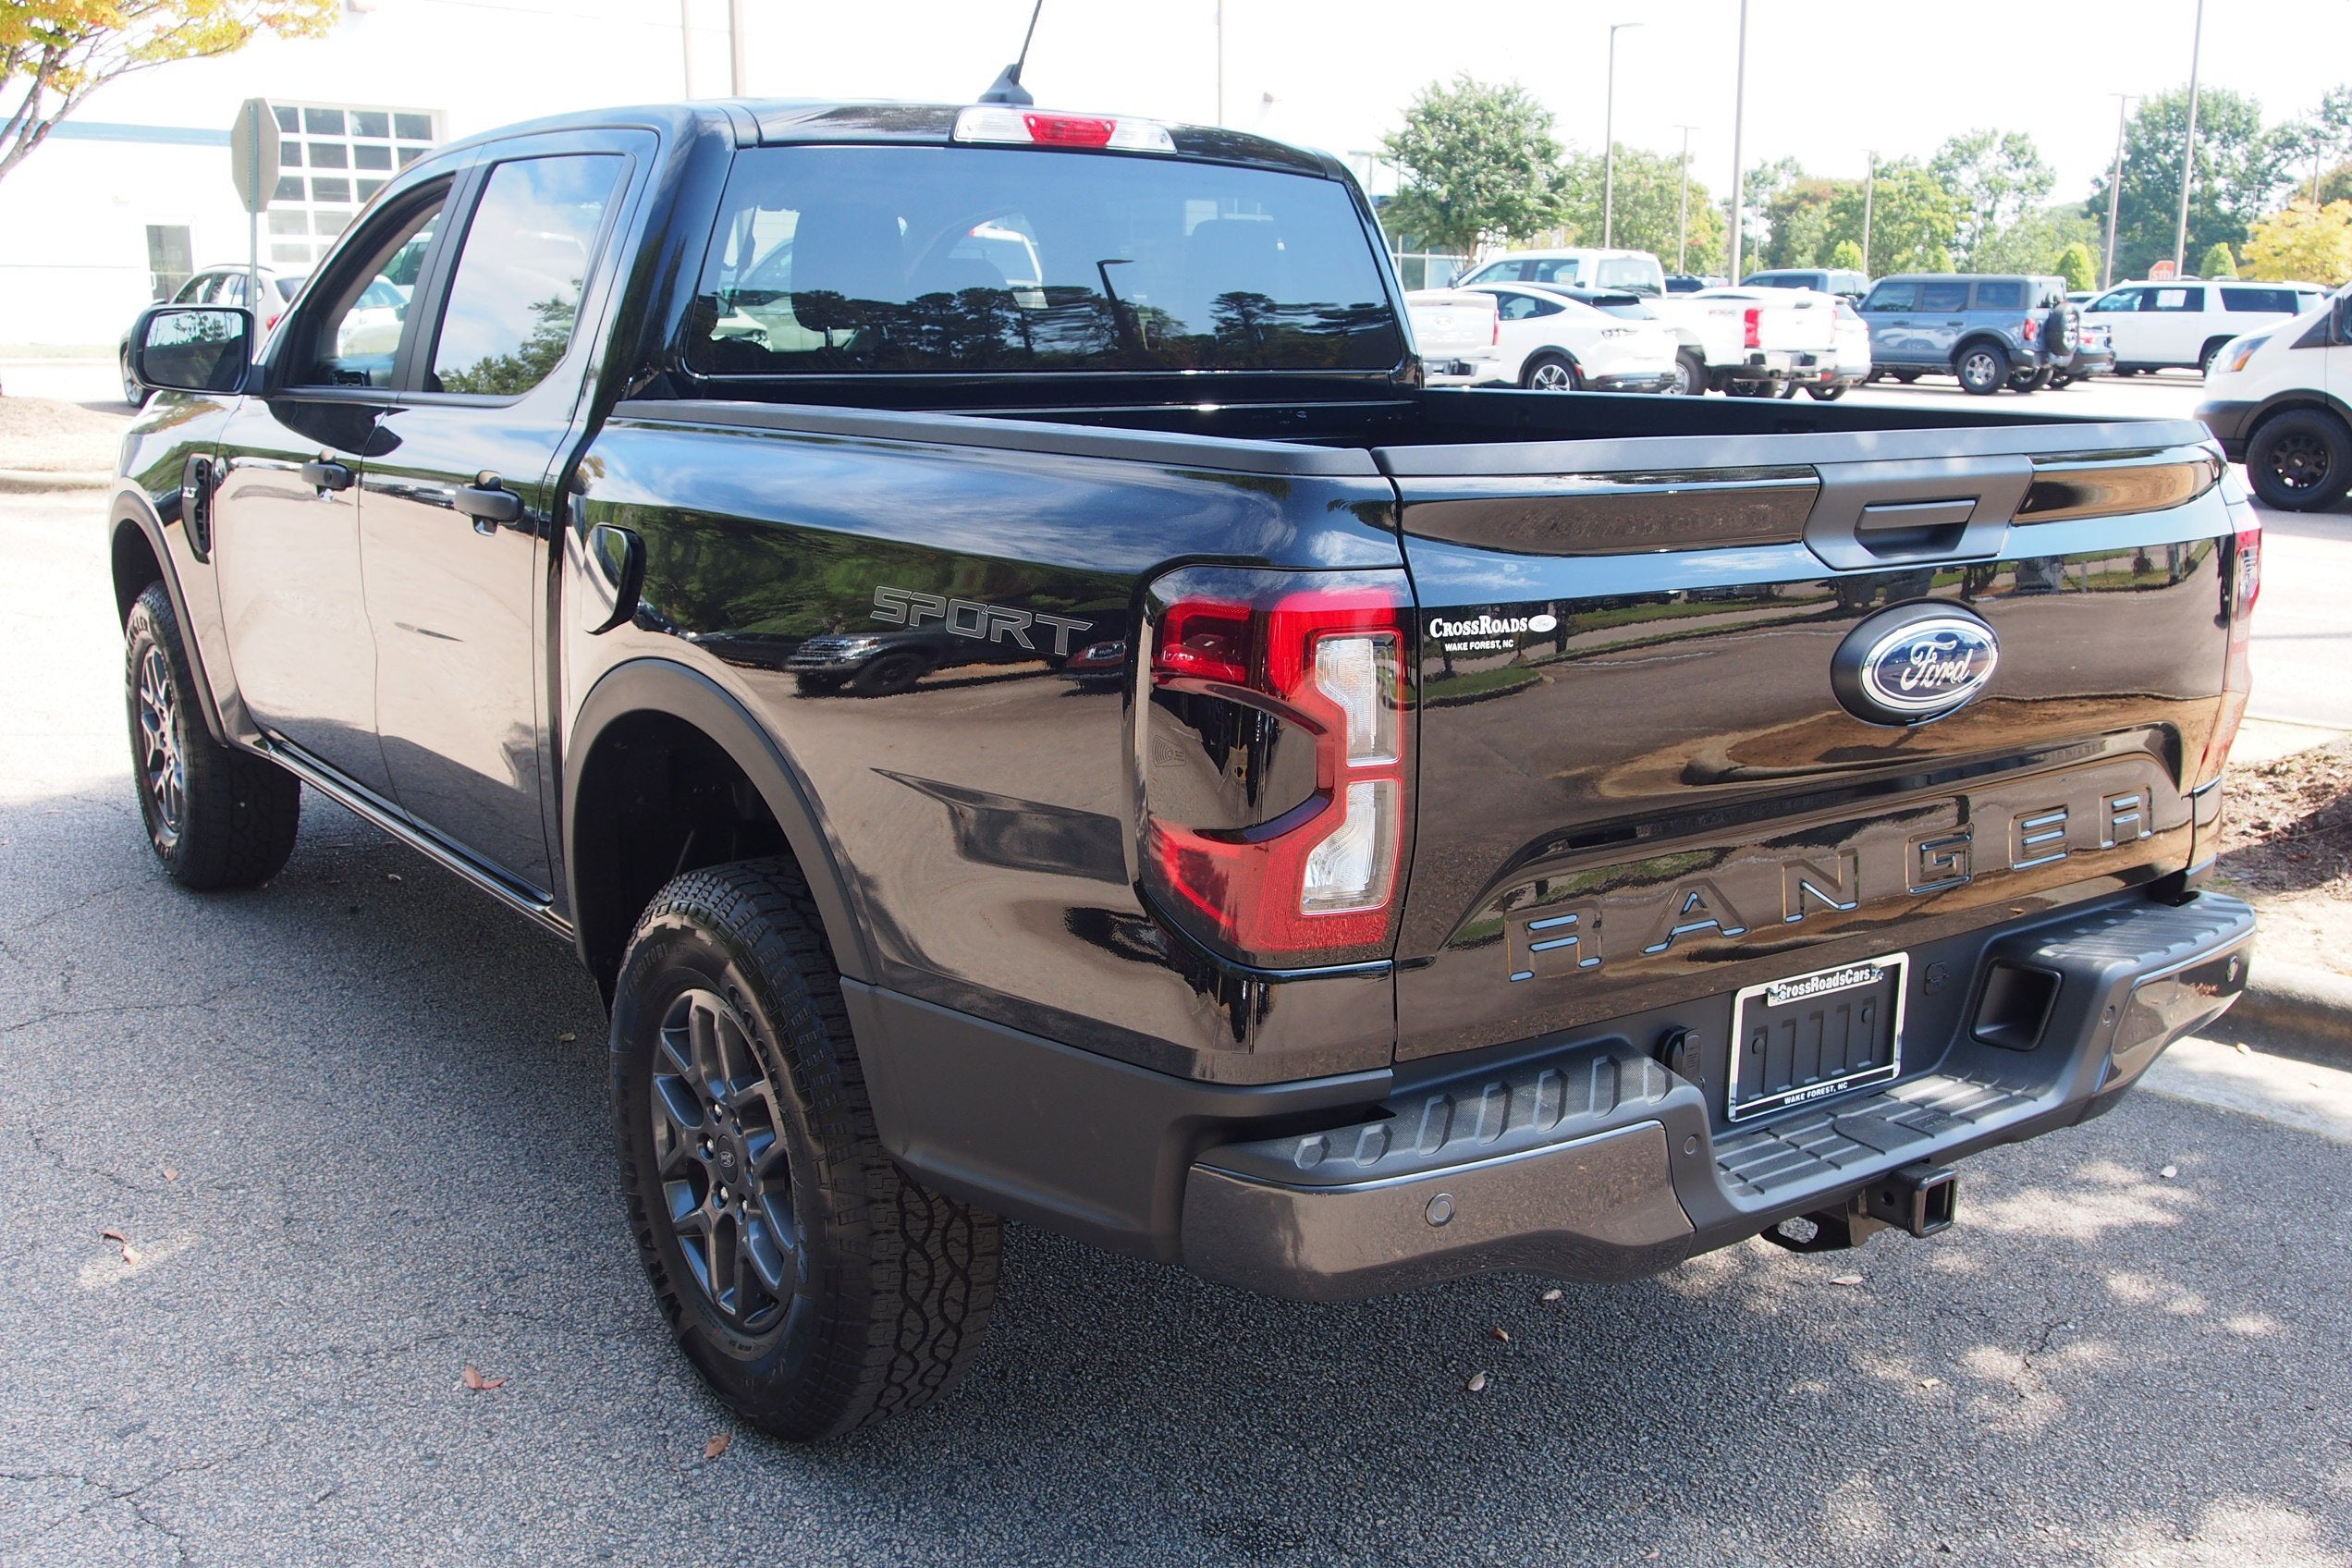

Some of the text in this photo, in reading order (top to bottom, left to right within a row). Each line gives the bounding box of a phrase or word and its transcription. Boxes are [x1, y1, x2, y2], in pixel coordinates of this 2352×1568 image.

[2151, 270, 2174, 281] STO
[869, 585, 1094, 656] SPORT
[1444, 638, 1514, 652] WAKE FOREST, NC
[1900, 639, 1974, 691] Ford
[1505, 785, 2153, 983] RANGER
[1783, 1082, 1848, 1105] WAKE FOREST, NC
